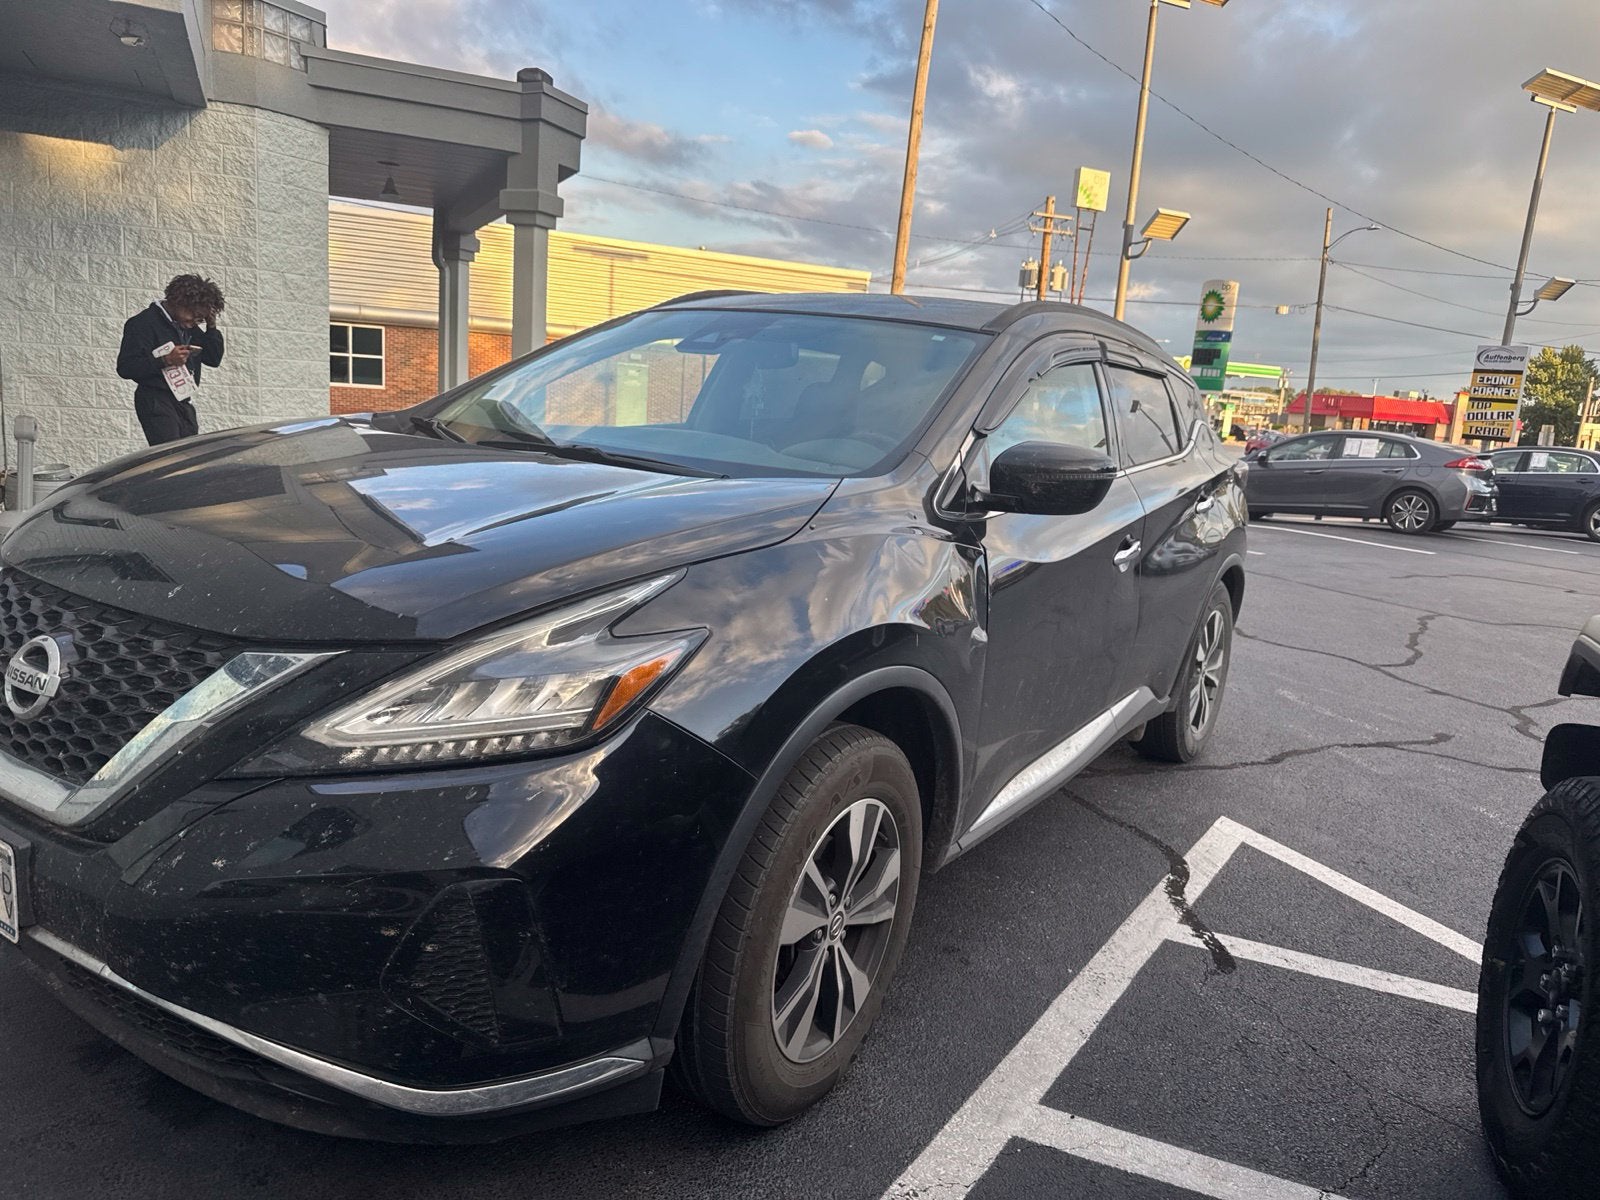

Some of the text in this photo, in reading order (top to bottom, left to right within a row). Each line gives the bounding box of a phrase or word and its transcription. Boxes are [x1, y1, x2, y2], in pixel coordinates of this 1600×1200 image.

[1221, 283, 1231, 291] bp
[1484, 354, 1525, 362] Auffenberg
[1476, 375, 1516, 386] ECONO
[1471, 386, 1518, 397] CORNER
[1471, 401, 1492, 410] TOP
[1467, 411, 1515, 421] DOLLAR
[1469, 426, 1509, 436] TRADE
[6, 664, 48, 691] NISSAN
